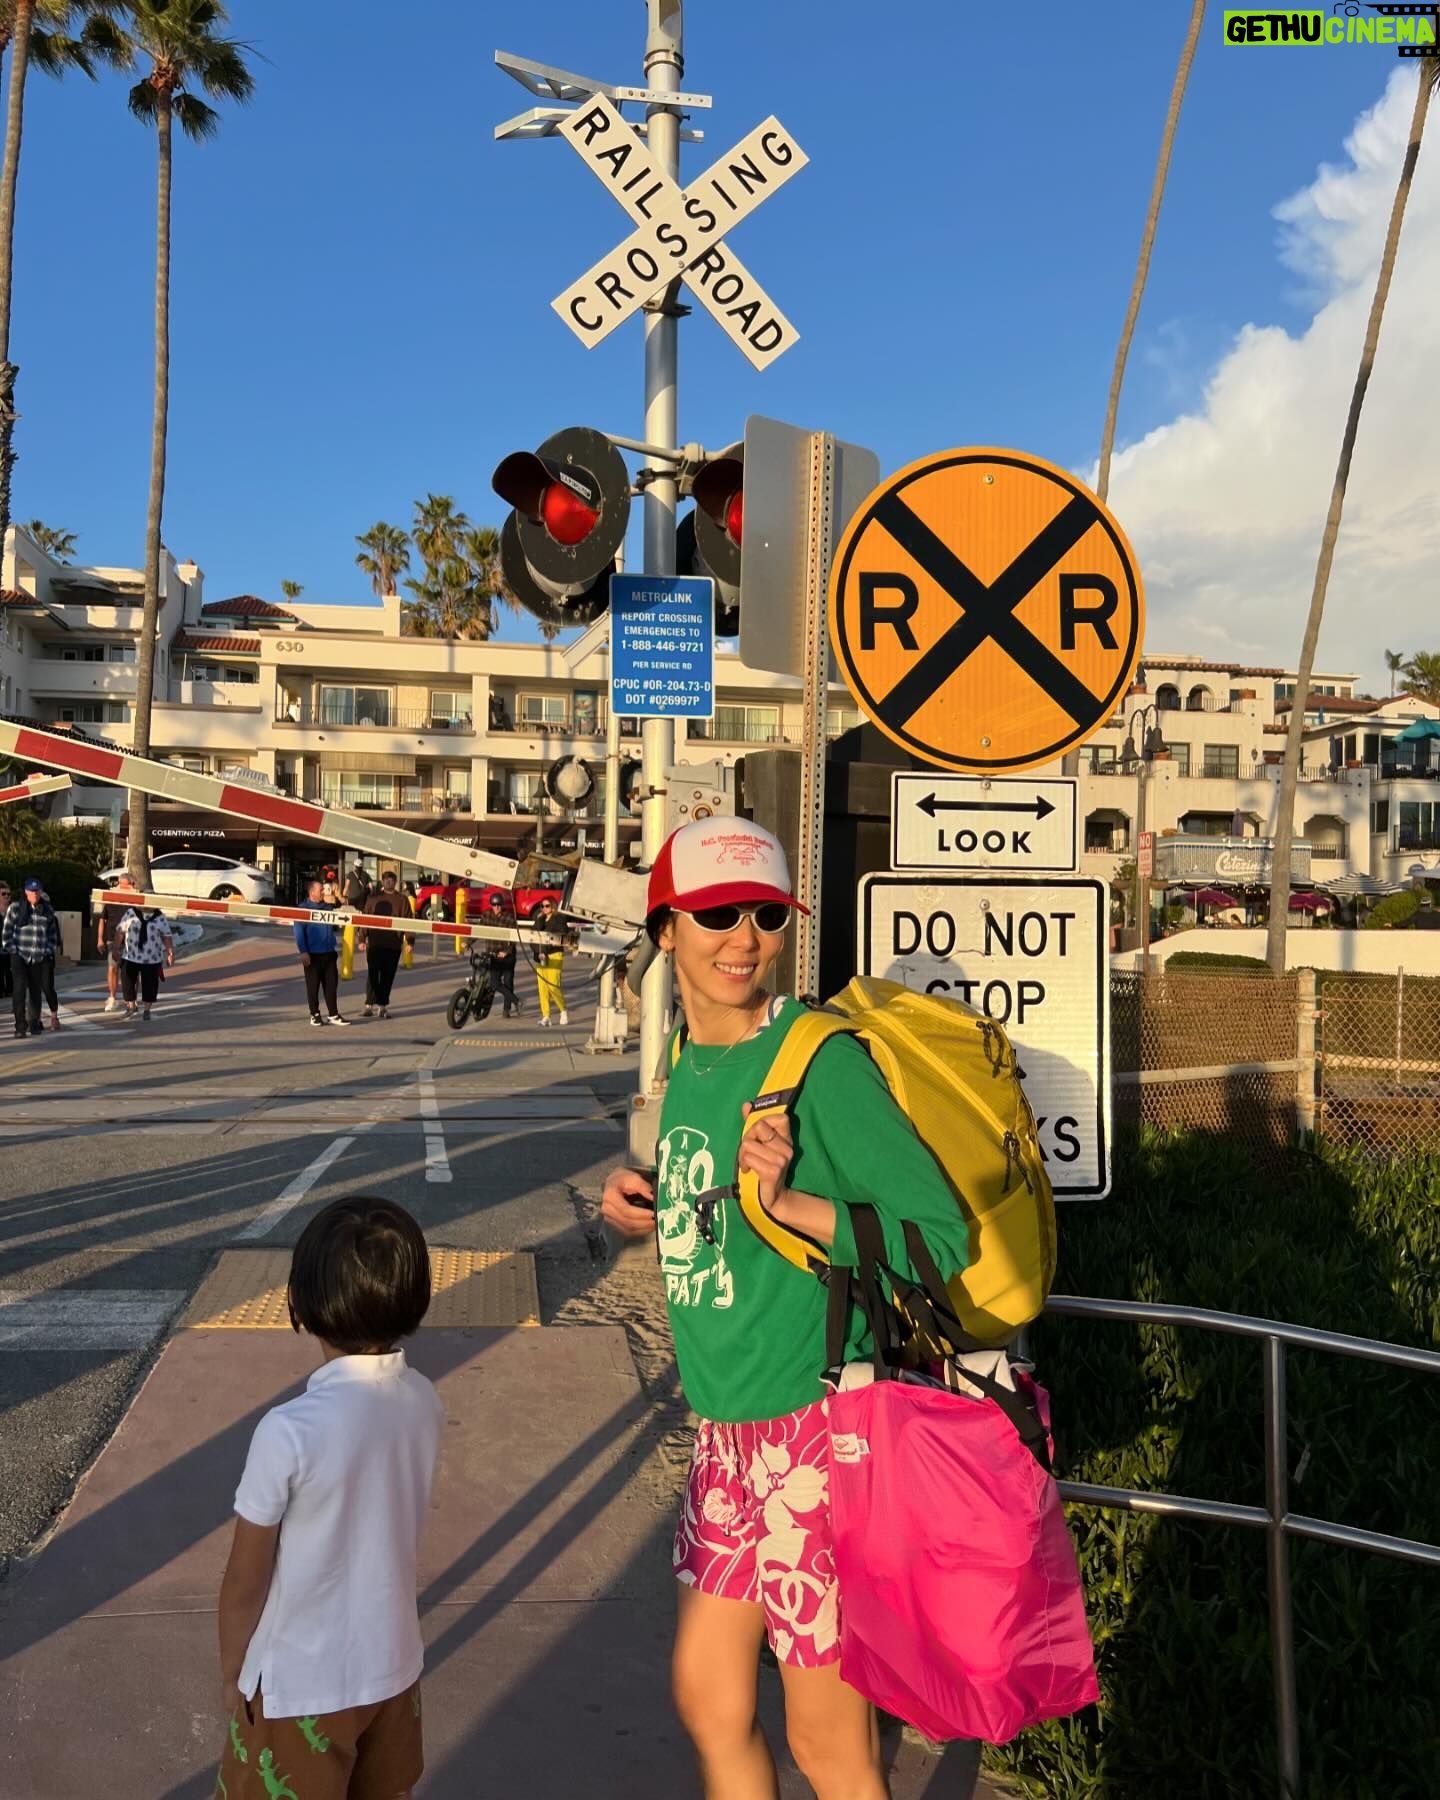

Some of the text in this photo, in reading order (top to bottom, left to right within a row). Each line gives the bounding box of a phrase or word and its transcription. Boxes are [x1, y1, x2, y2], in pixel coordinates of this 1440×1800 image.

[570, 132, 792, 331] CROSSING
[572, 106, 783, 352] RAIL ROAD
[631, 591, 693, 604] METROLINK
[859, 572, 1119, 650] R R
[621, 612, 703, 624] REPORT CROSSING
[624, 626, 700, 638] EMERGENCIES TO
[276, 641, 304, 653] 630
[621, 639, 704, 653] 1-888-446-9721
[632, 661, 692, 671] PIER SERVICE RD
[613, 678, 640, 690] CPUC
[625, 694, 646, 705] DOT
[203, 830, 226, 839] PIZZA
[1139, 833, 1151, 848] NO
[938, 829, 1032, 854] LOOK
[311, 911, 338, 923] EXIT
[892, 910, 1076, 958] DO NOT
